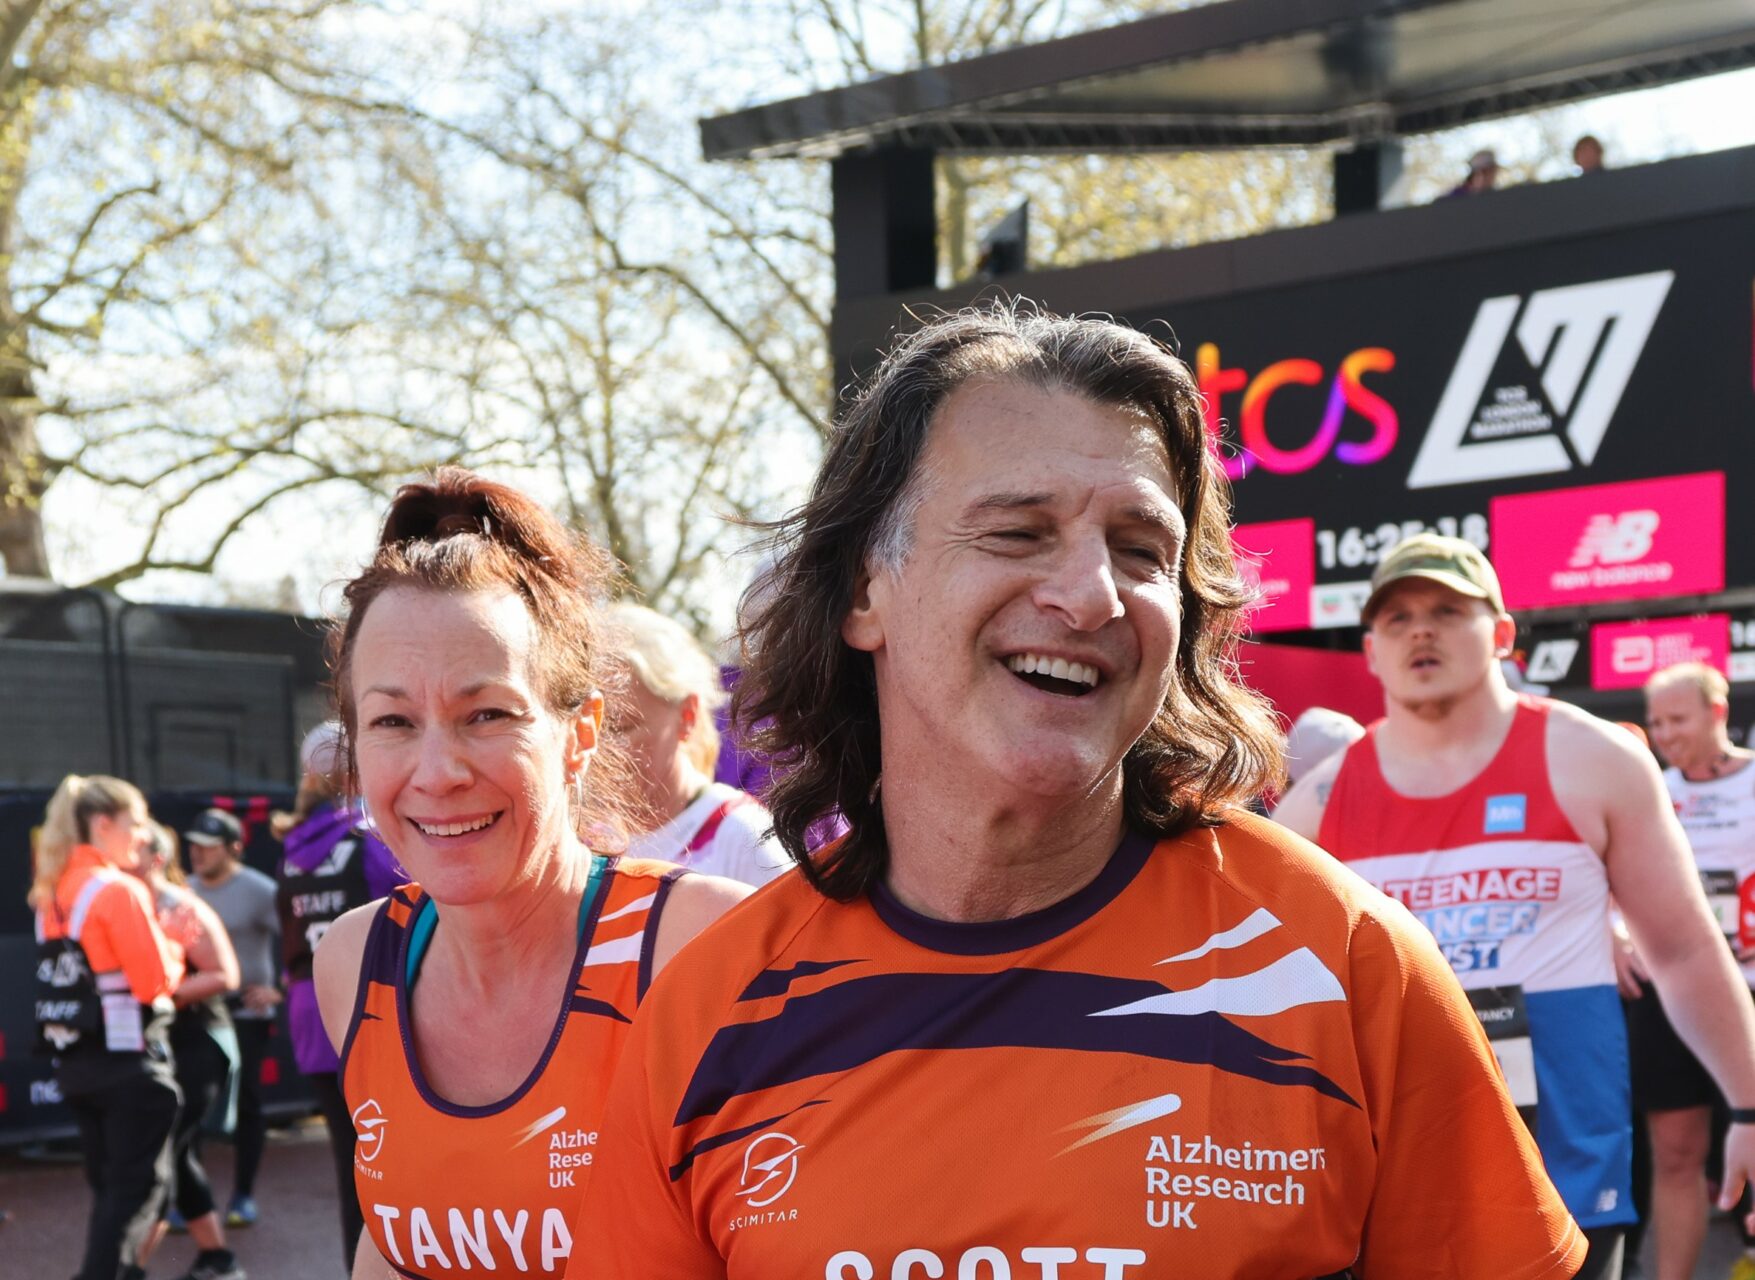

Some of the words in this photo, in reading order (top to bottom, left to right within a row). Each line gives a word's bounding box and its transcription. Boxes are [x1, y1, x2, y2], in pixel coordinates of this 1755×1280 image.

[1197, 342, 1398, 480] tcs
[1387, 869, 1559, 908] TEENAGE
[549, 1152, 593, 1169] Rese
[549, 1171, 576, 1189] UK
[1145, 1167, 1305, 1205] Research
[729, 1208, 798, 1232] SCIMITAR
[1146, 1199, 1198, 1230] UK
[373, 1203, 573, 1272] TANYA
